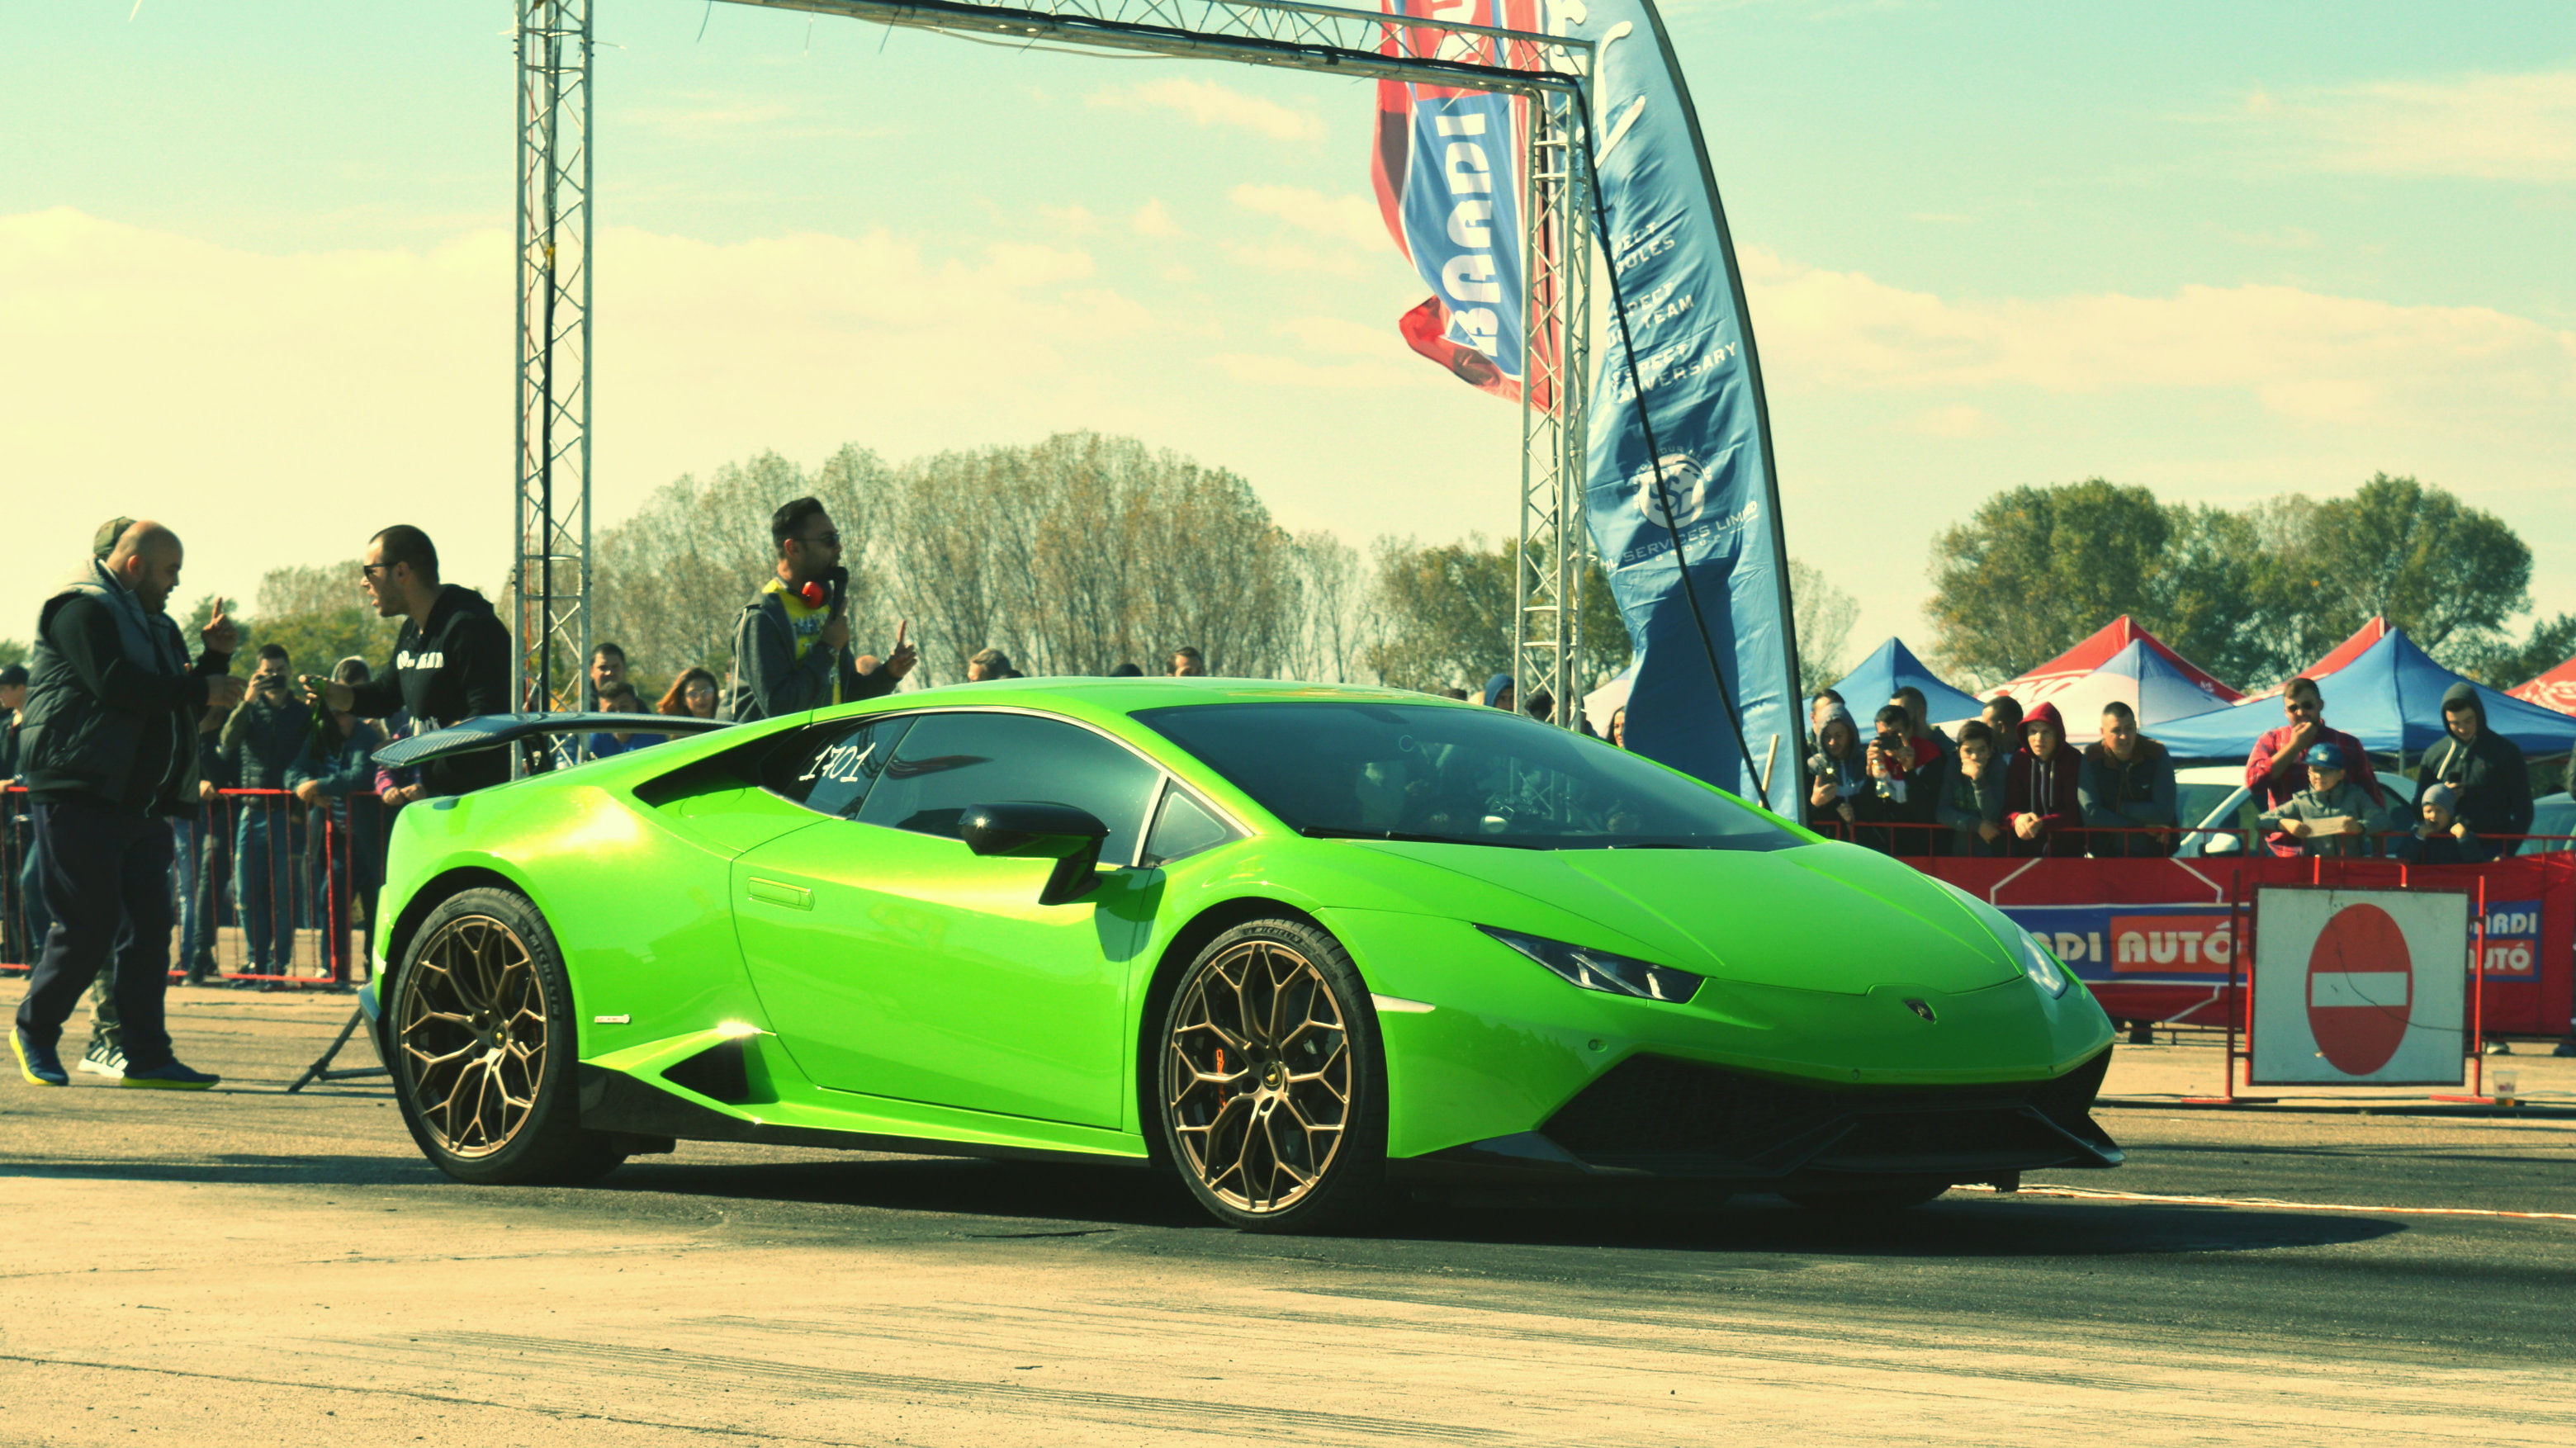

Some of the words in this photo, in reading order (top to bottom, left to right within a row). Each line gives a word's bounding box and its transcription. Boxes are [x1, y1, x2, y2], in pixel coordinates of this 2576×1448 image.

[1622, 525, 1711, 562] SERVICES
[798, 742, 876, 783] 1701
[2117, 920, 2242, 964] AUTÓ
[528, 934, 561, 1015] MICHELIN
